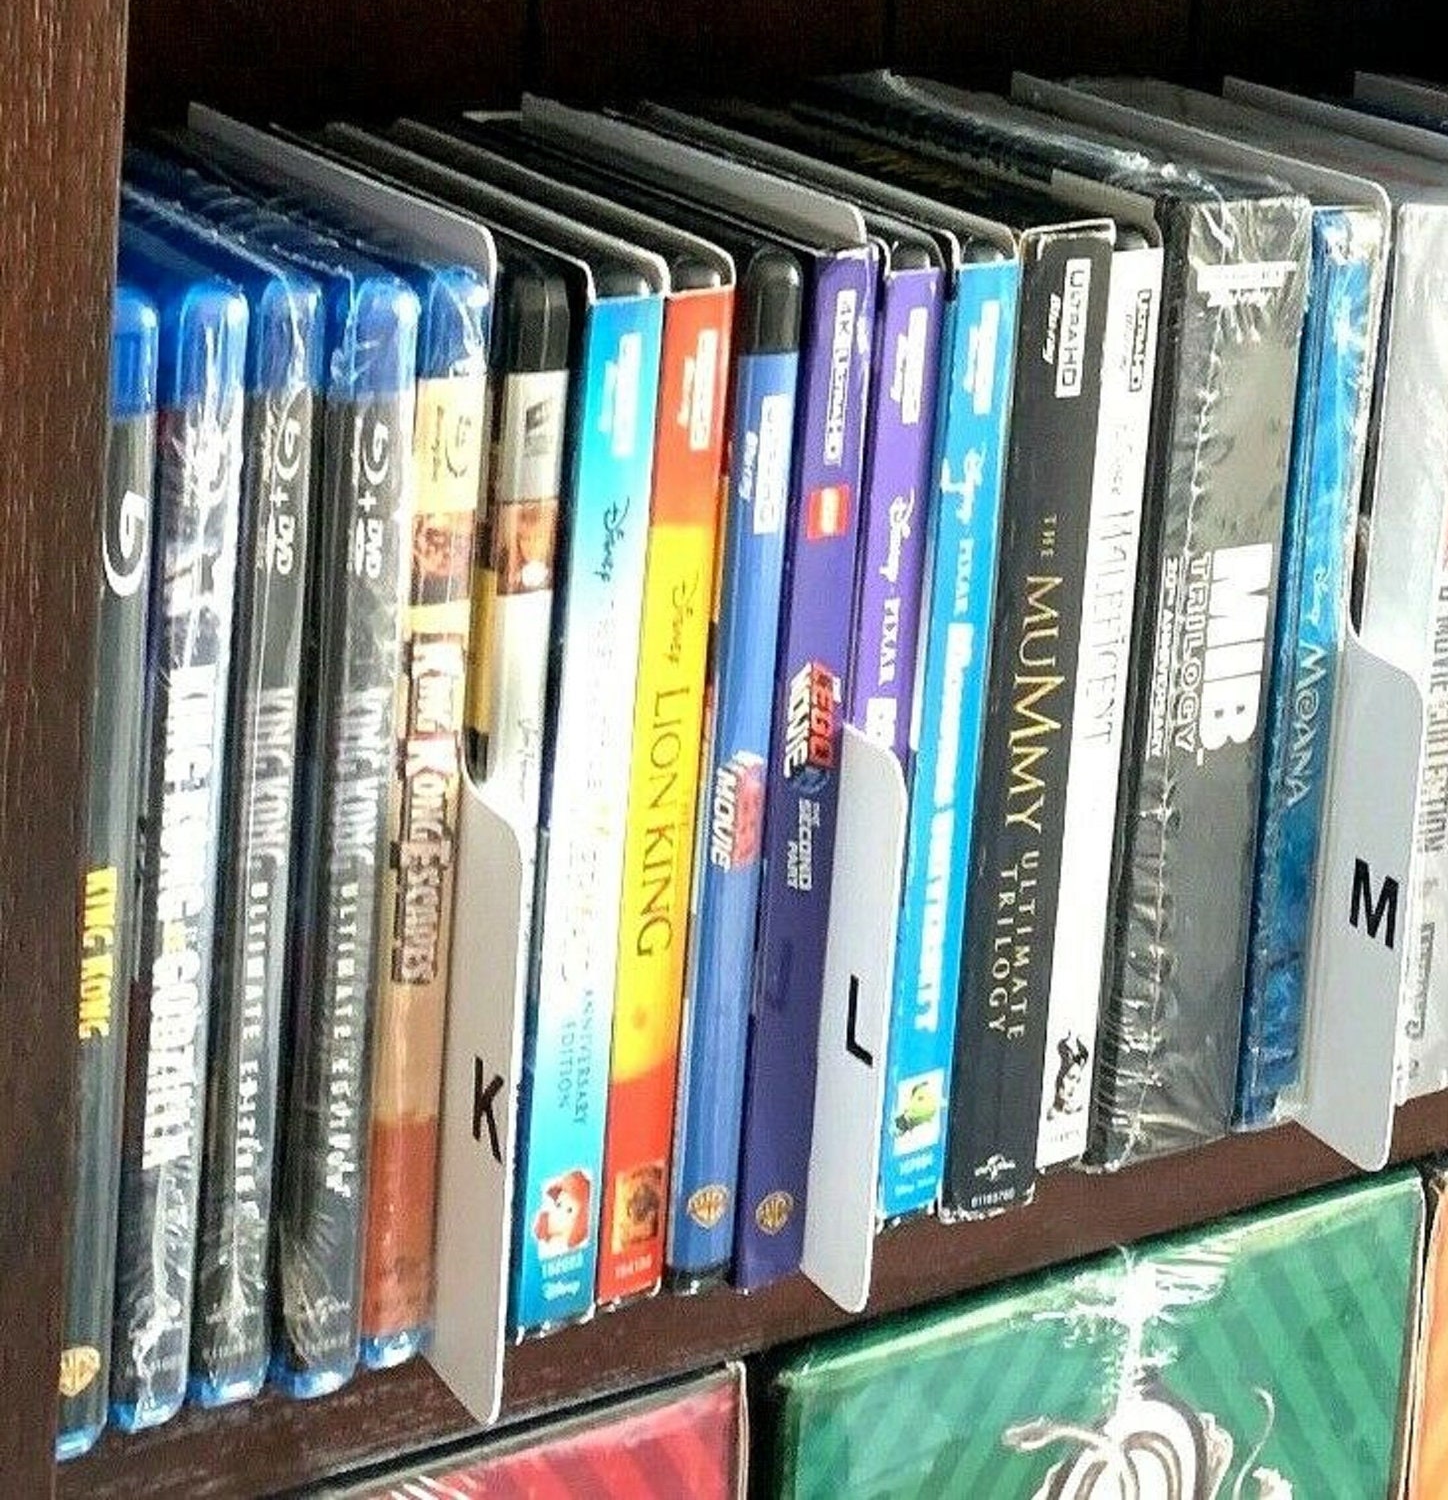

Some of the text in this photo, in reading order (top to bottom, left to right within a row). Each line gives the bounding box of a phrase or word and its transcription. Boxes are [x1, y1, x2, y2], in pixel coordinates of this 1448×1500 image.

[365, 518, 384, 579] DVD
[877, 597, 902, 686] PIXAR
[1173, 553, 1213, 753] TRILOGY
[783, 663, 814, 779] MOVIE
[1283, 638, 1326, 810] MOANA
[635, 686, 690, 958] LION KING
[710, 765, 740, 872] MOVIE
[1005, 513, 1067, 1040] THE MUMMY ULTIMATE
[785, 840, 799, 890] PART
[797, 798, 814, 893] SECOND
[82, 865, 119, 950] KING
[987, 864, 1018, 1035] TRILOGY
[1349, 858, 1400, 949] M
[845, 973, 873, 1067] L
[472, 1055, 506, 1166] K
